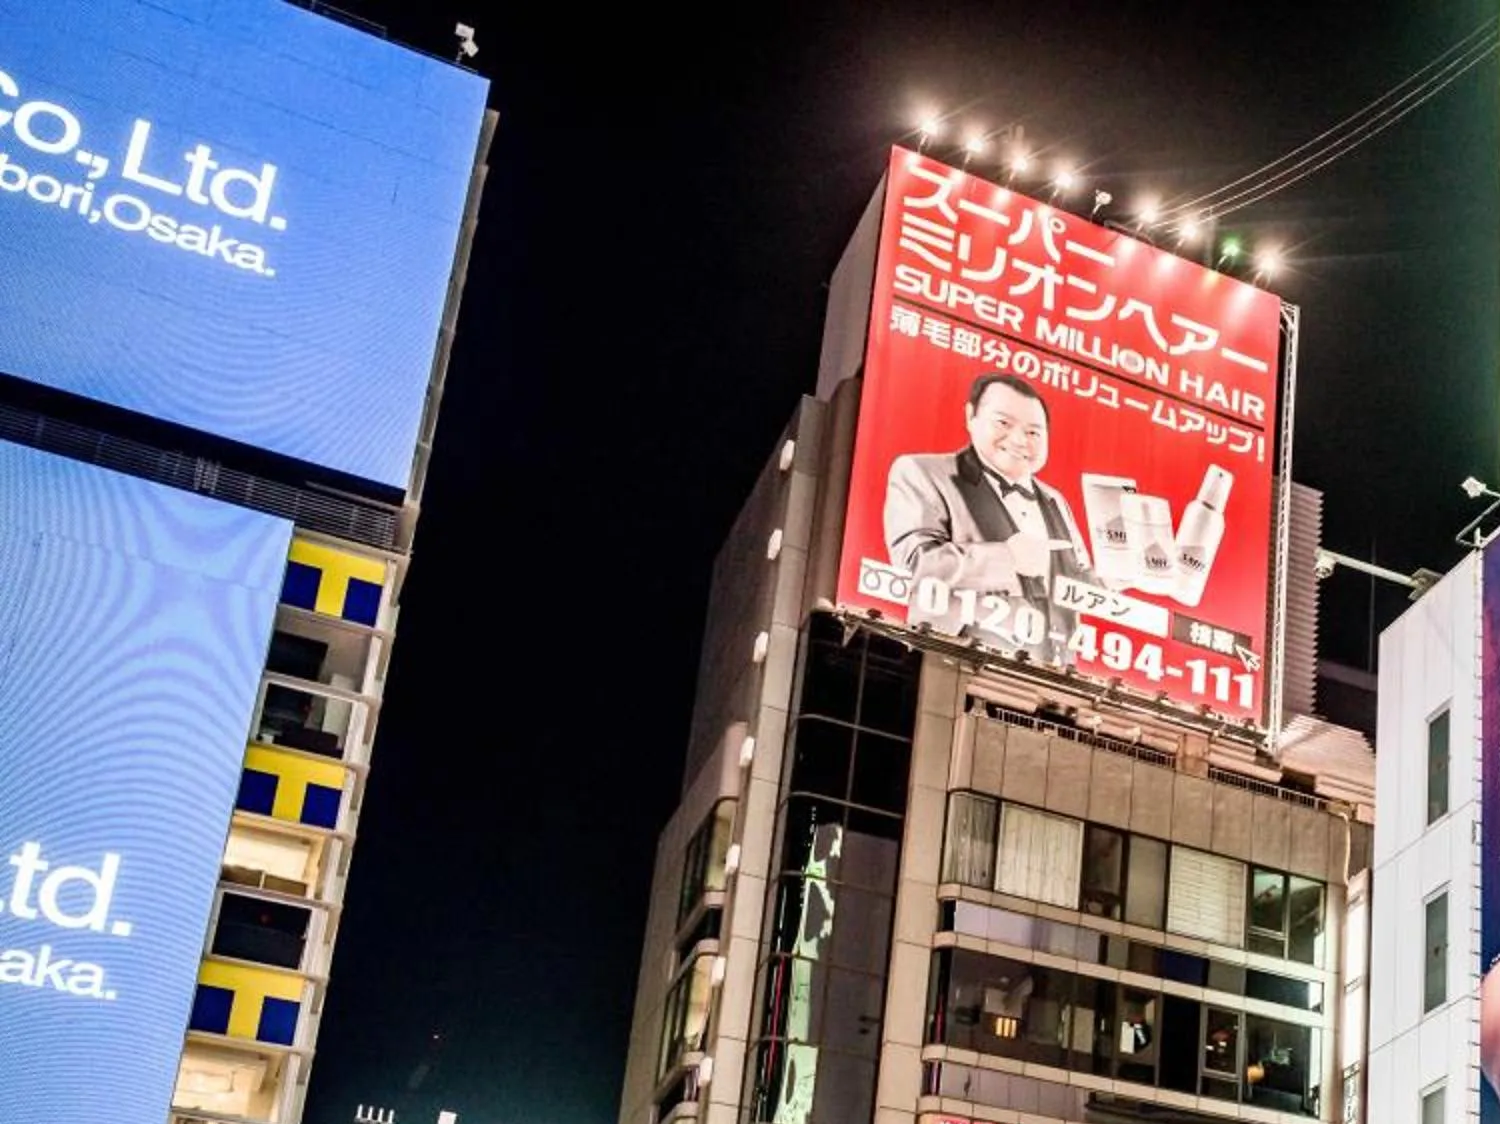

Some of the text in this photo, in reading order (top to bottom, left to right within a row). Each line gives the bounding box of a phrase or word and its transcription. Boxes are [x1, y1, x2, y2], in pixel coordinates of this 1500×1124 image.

[903, 166, 1116, 268] スーパー
[894, 264, 1266, 422] SUPER MILLION HAIR
[899, 211, 1269, 373] ミリオンヘアー
[916, 577, 1257, 710] 0120-494-111
[1060, 581, 1134, 618] ルアン
